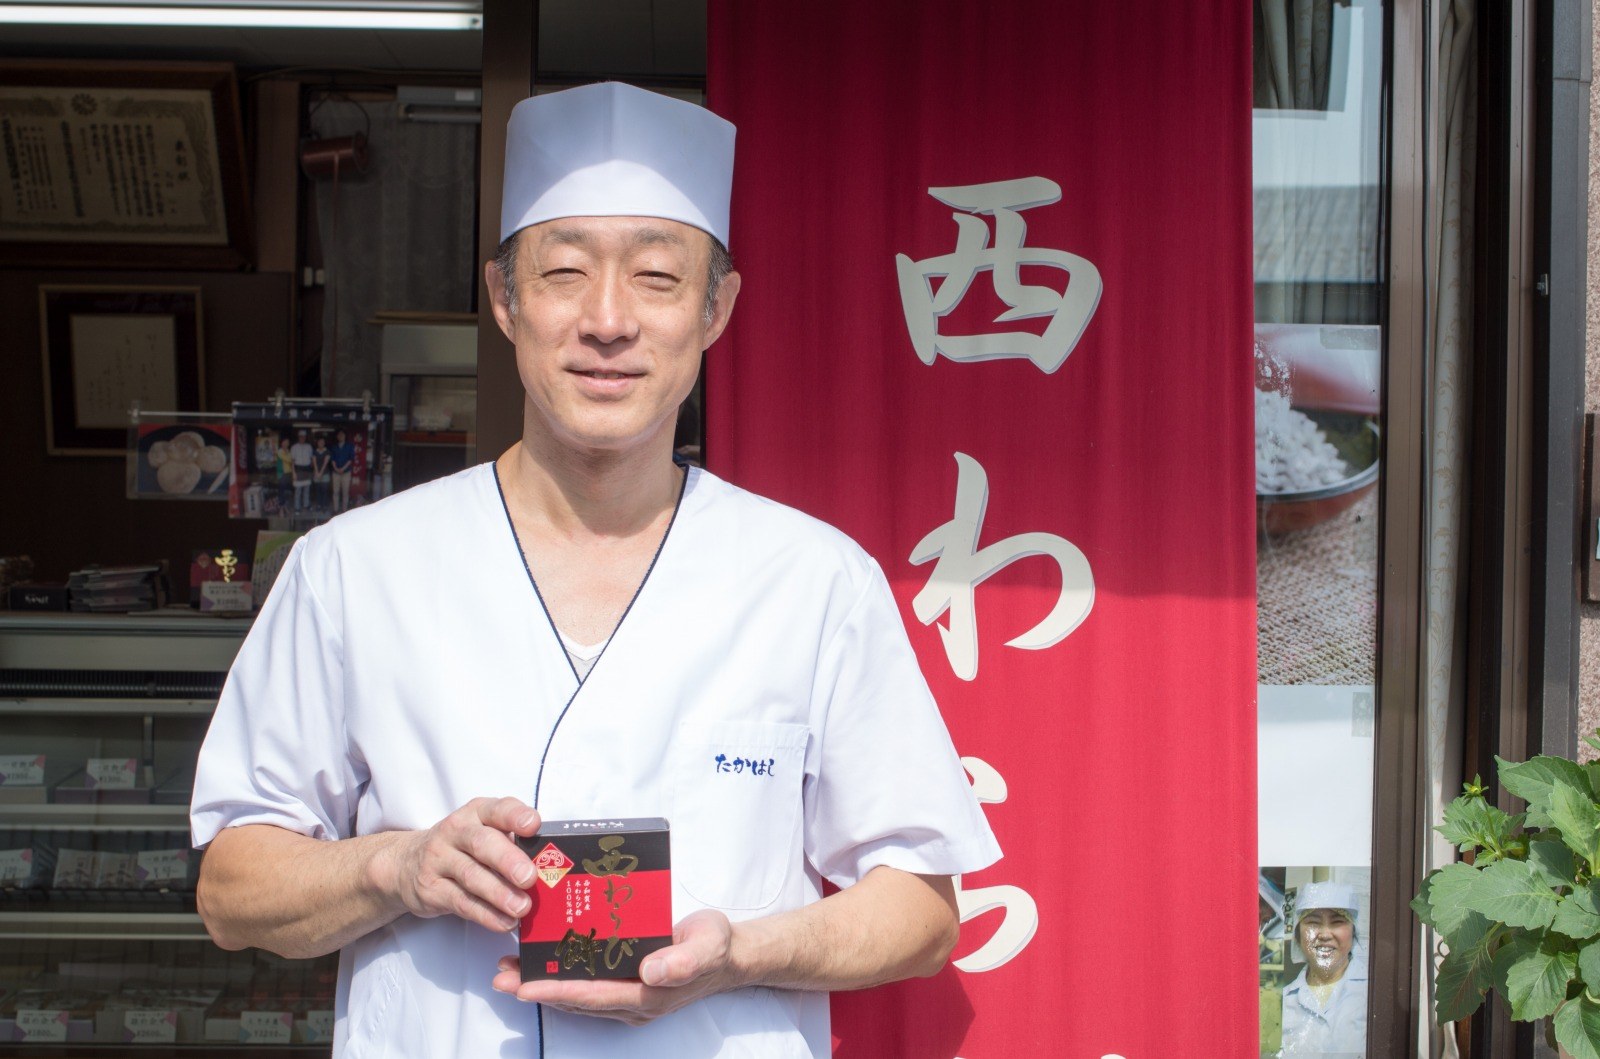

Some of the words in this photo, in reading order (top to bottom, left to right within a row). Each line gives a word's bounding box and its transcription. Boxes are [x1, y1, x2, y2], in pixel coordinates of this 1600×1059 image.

[715, 753, 775, 776] たかはし
[896, 176, 1126, 1059] 西わら
